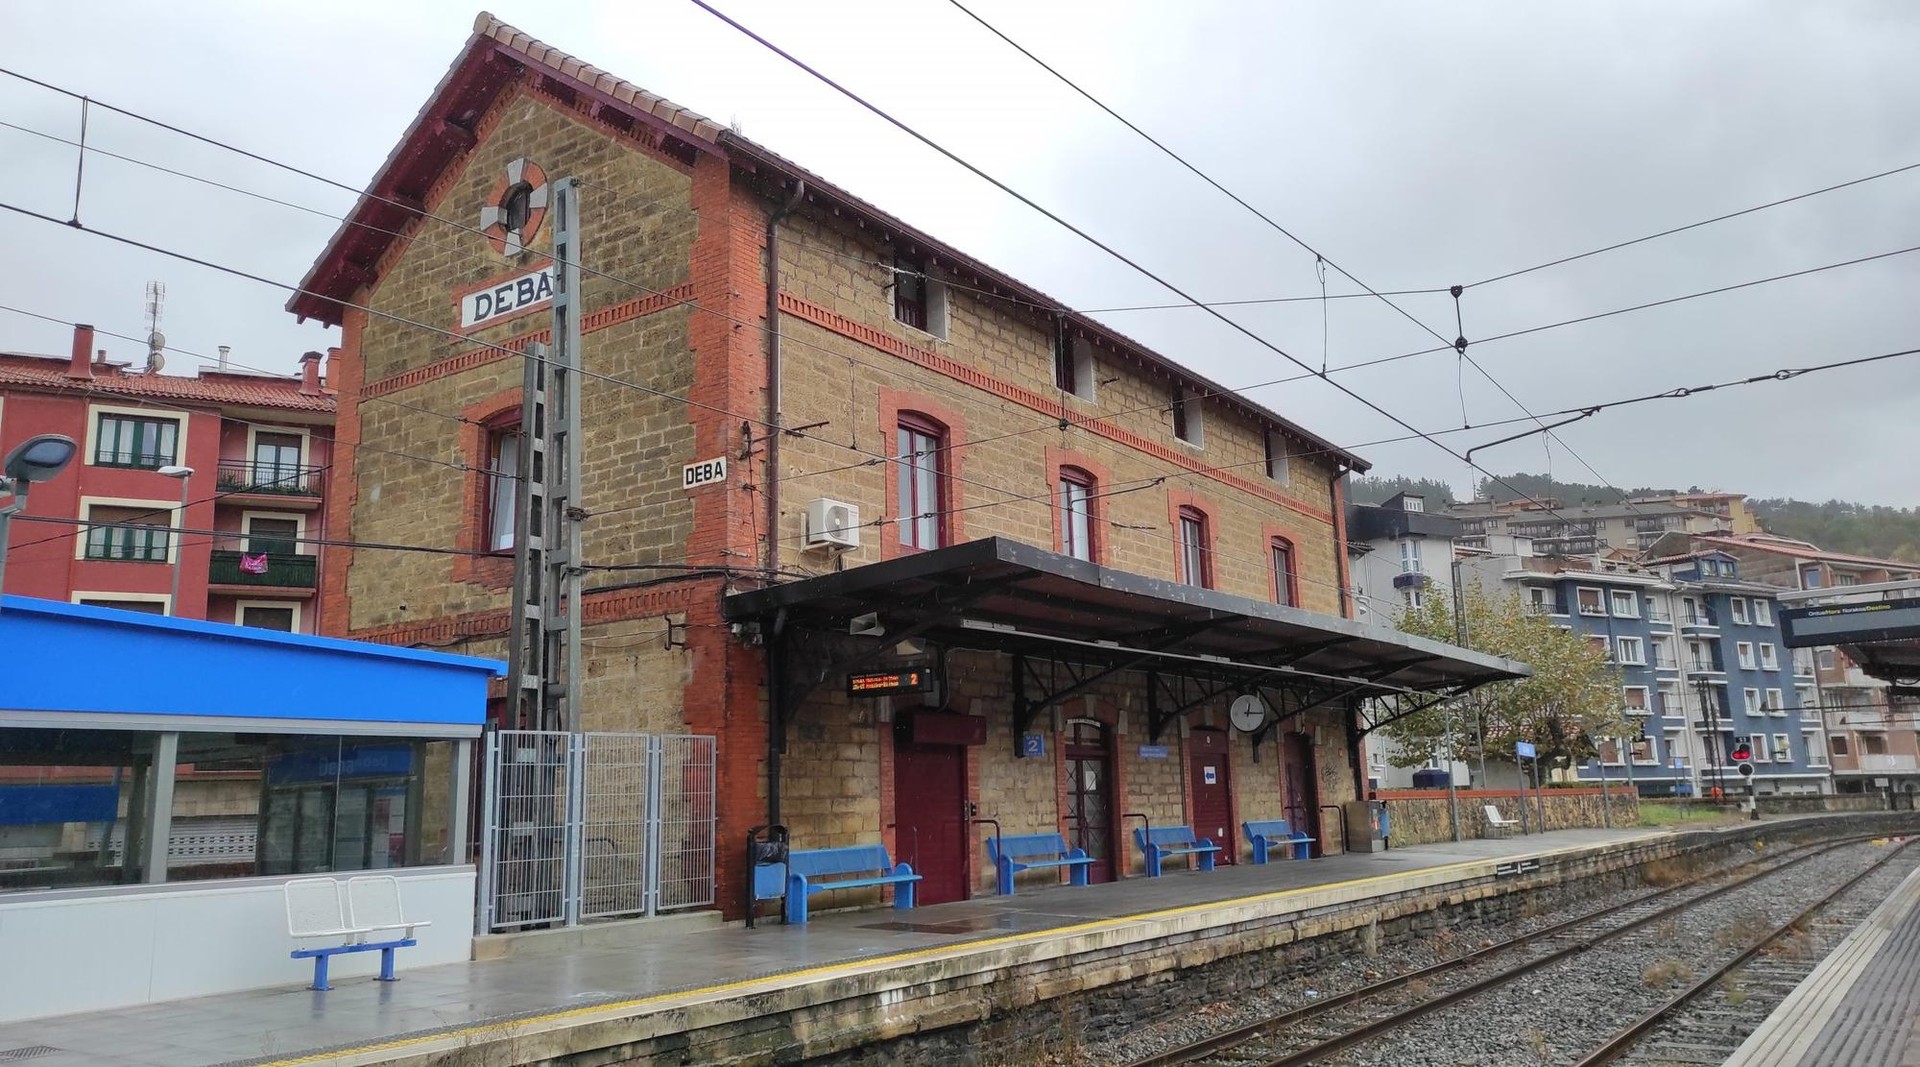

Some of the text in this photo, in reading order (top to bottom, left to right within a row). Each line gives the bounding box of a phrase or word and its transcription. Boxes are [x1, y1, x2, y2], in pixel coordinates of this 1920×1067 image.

[474, 271, 553, 321] DEBA
[686, 461, 723, 485] DEBA
[911, 673, 918, 685] 2
[1028, 740, 1038, 752] 2
